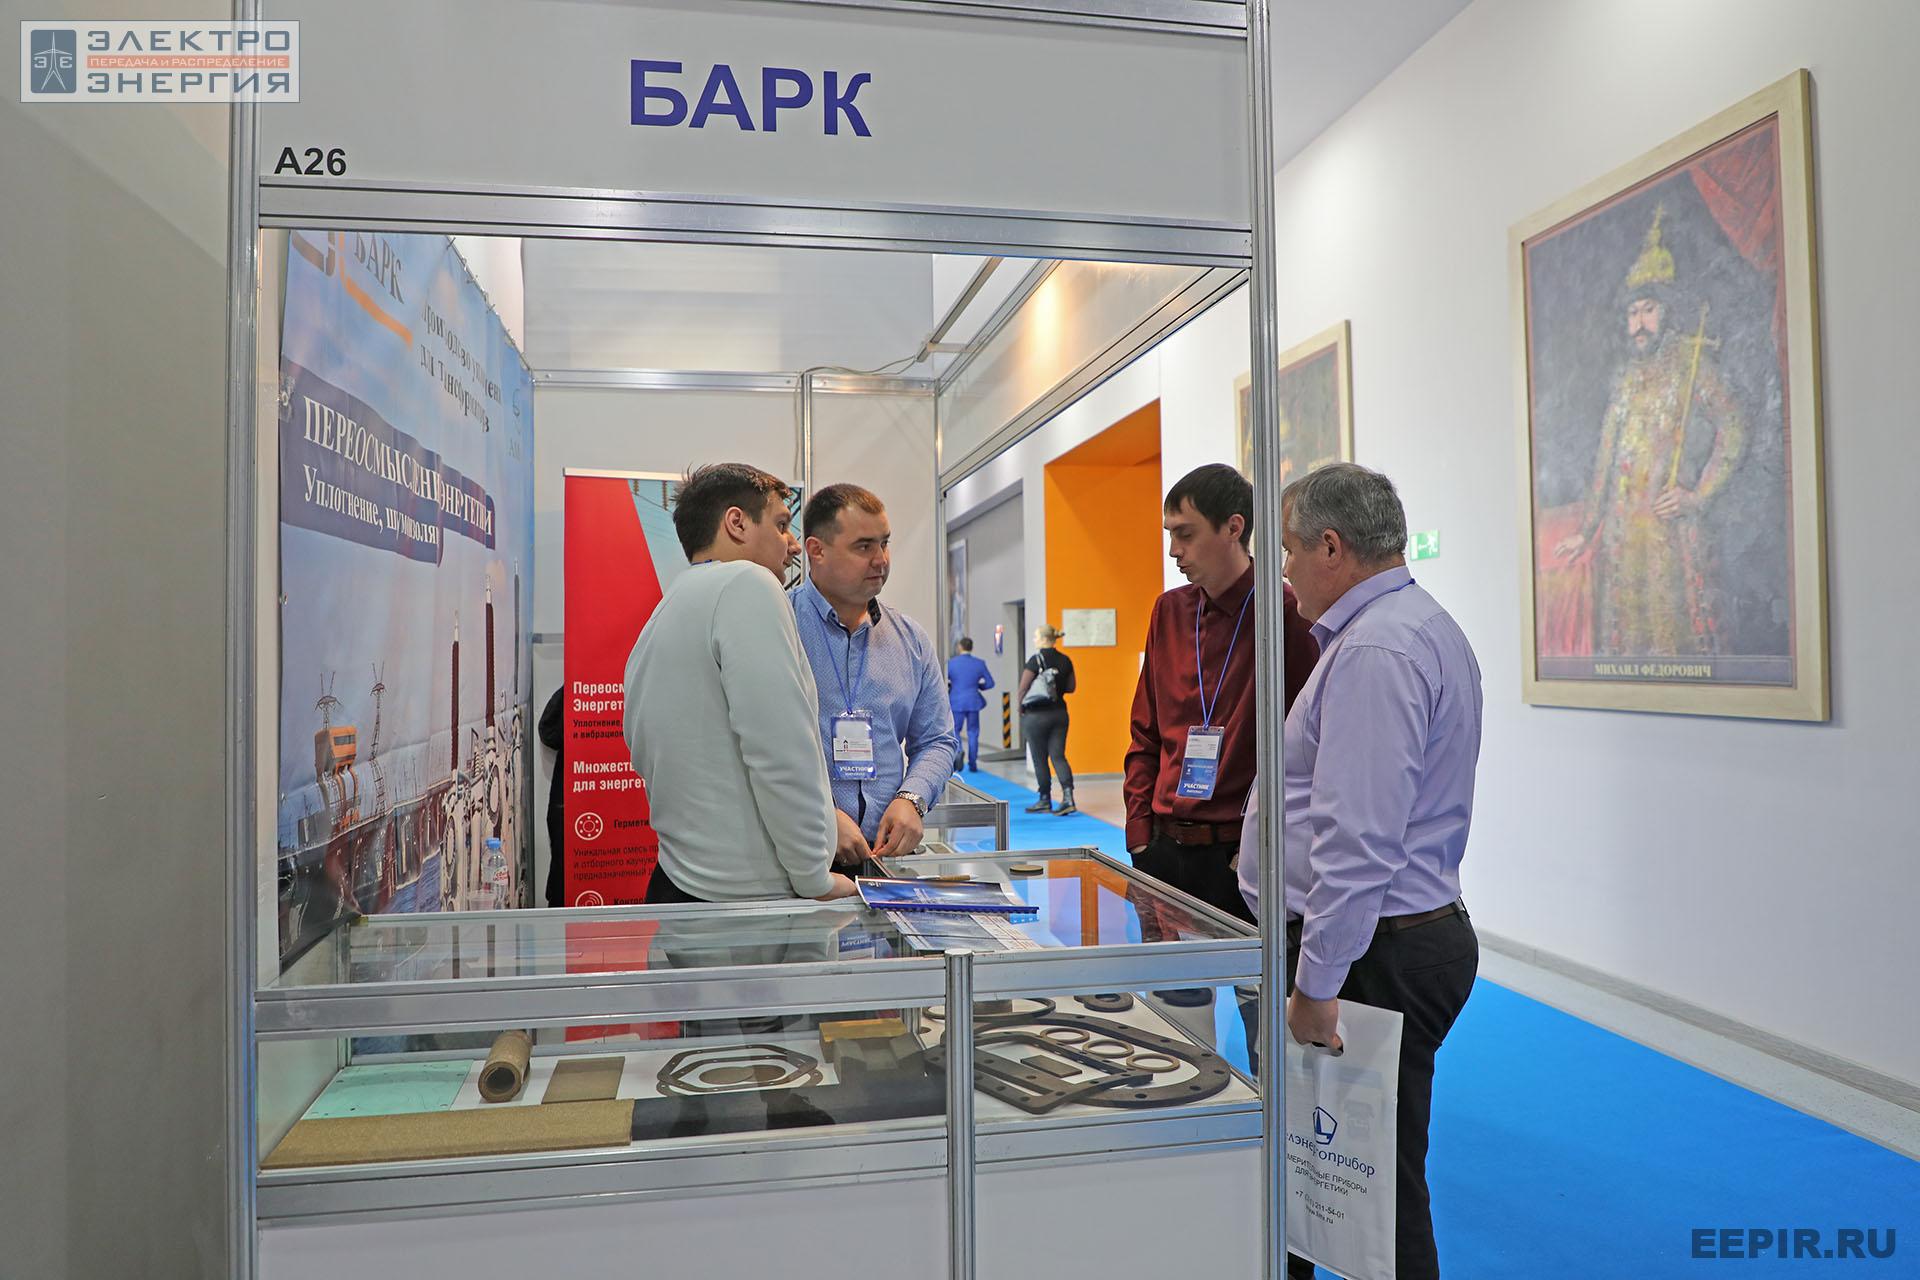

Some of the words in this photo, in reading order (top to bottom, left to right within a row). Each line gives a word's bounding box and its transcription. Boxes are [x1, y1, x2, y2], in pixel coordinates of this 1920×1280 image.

[631, 59, 872, 137] БАРК
[354, 231, 404, 304] БАРК
[573, 698, 624, 714] Энергет
[573, 780, 596, 793] для
